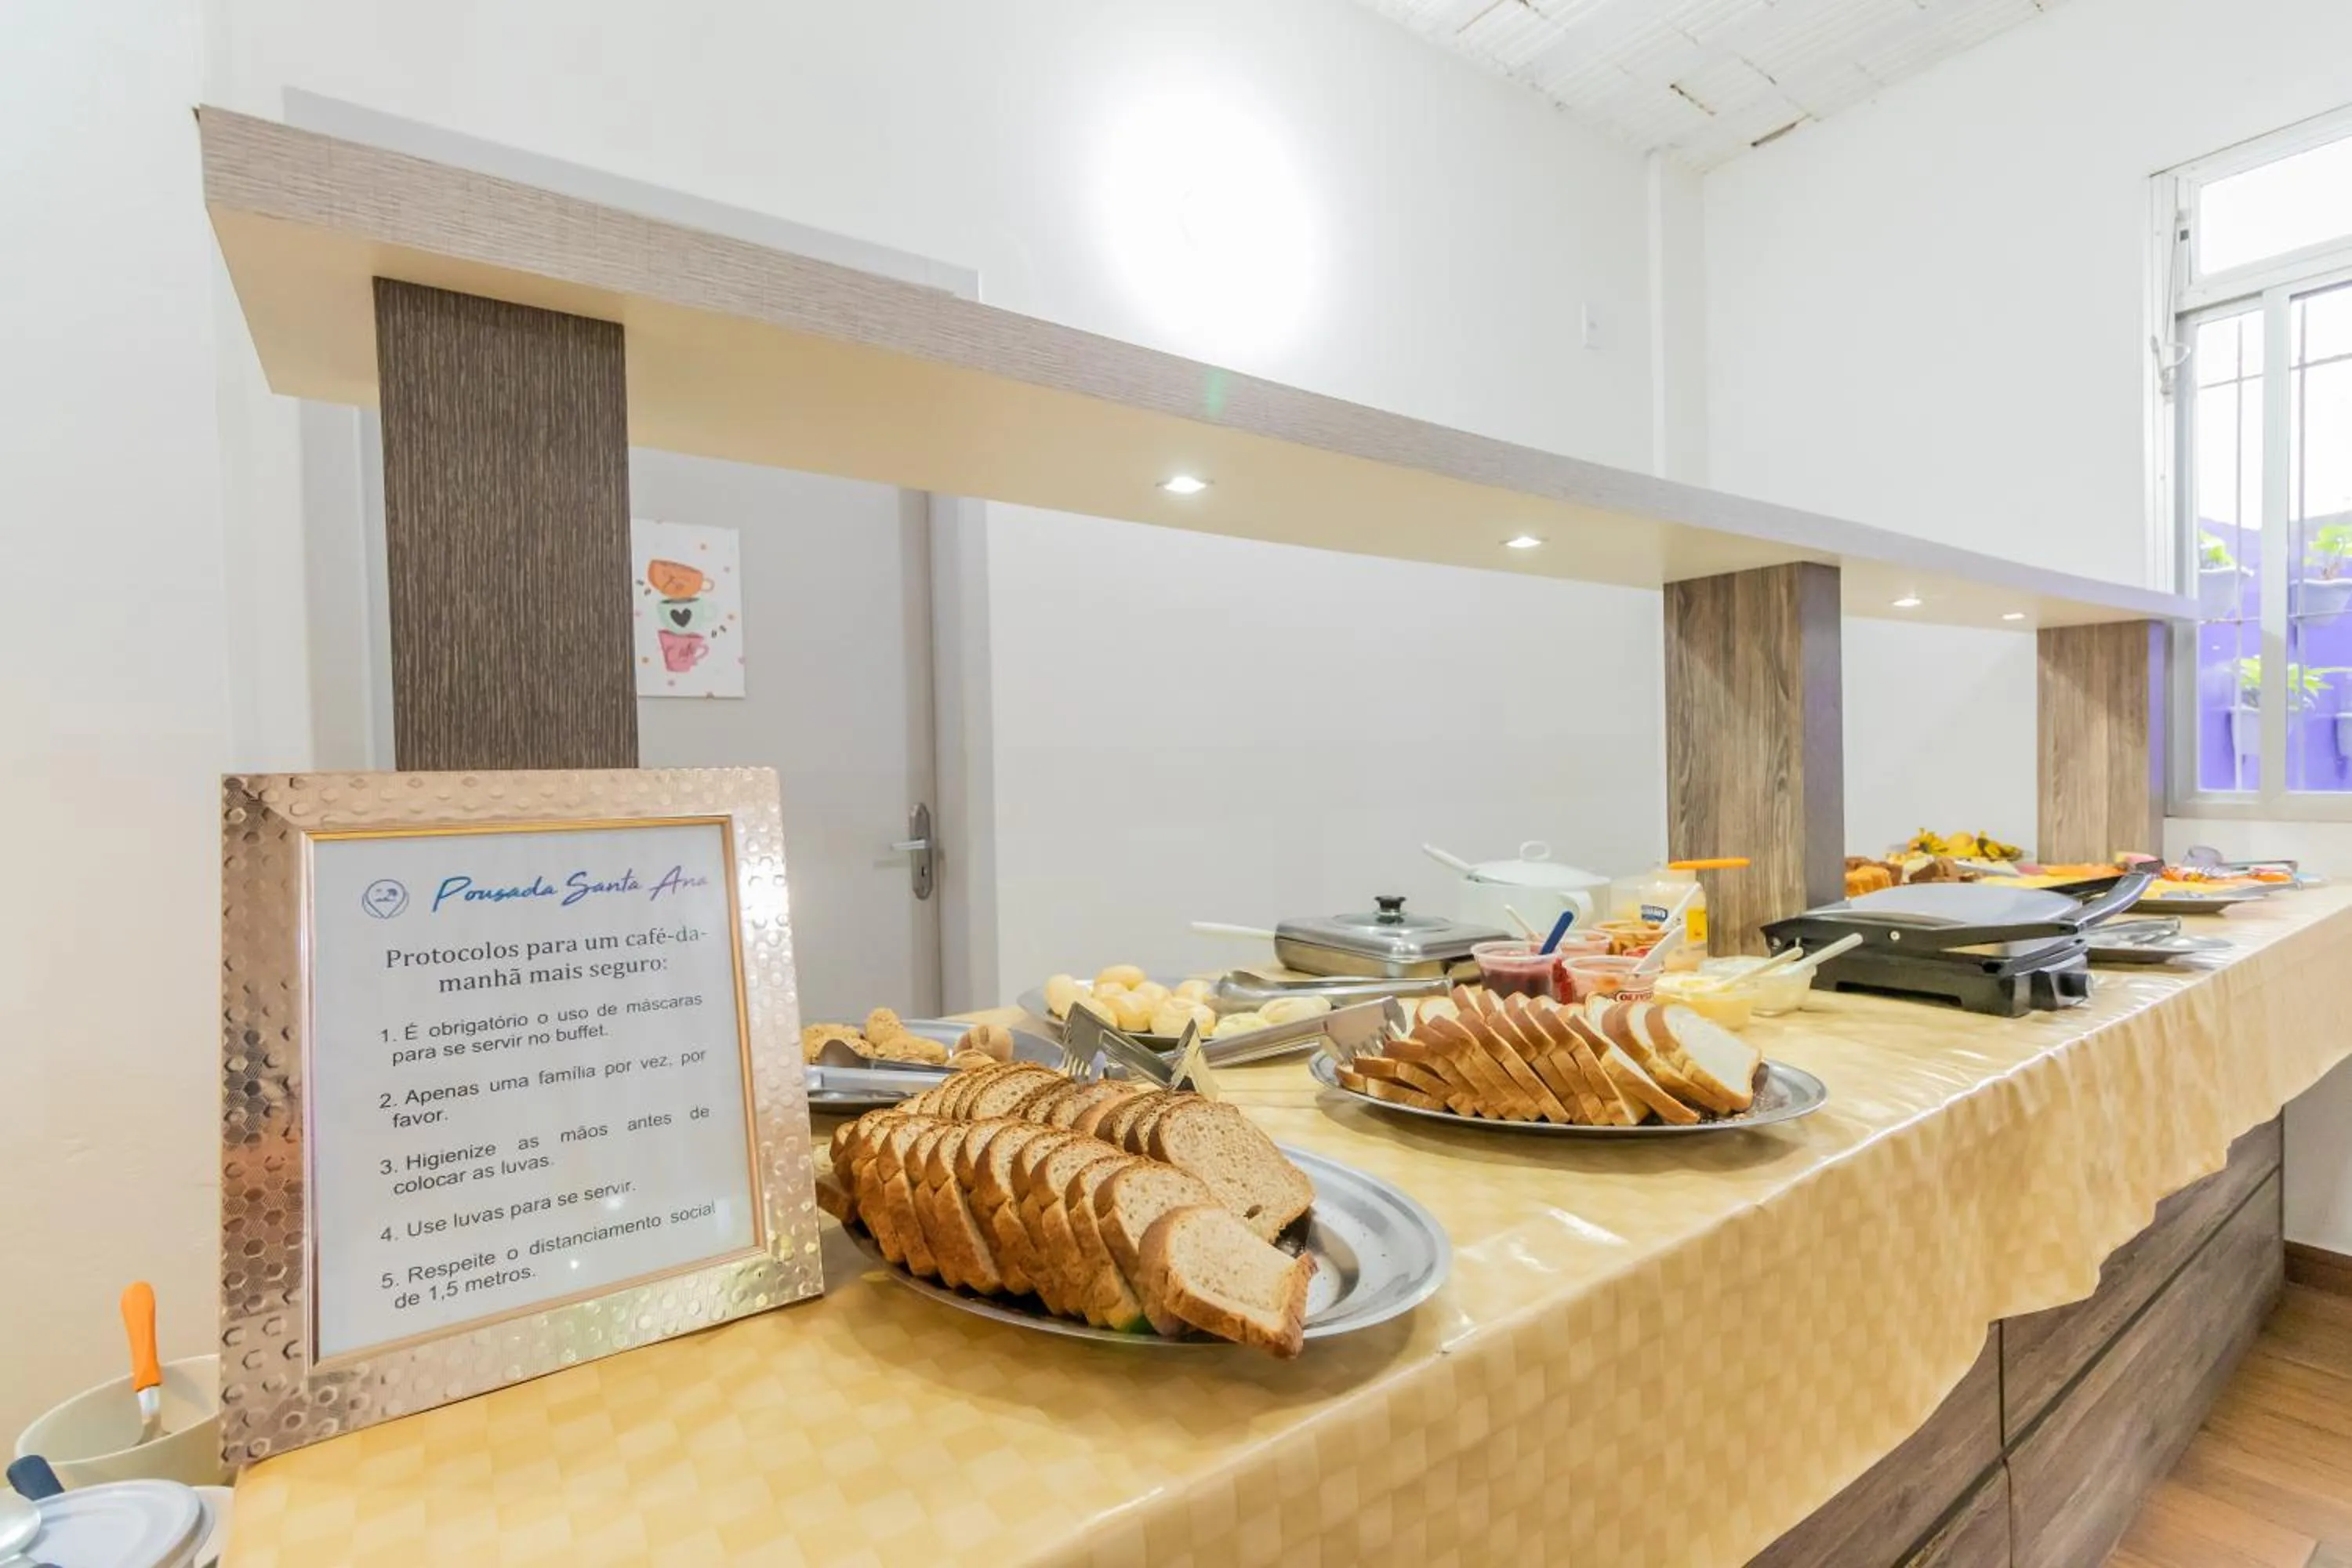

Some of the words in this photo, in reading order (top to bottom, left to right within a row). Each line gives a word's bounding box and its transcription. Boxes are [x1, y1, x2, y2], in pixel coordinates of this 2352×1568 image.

[431, 876, 557, 913] Pousada
[561, 870, 640, 906] Santa
[650, 866, 709, 902] Ana
[386, 942, 519, 968] Protocolos
[526, 938, 578, 960] para
[585, 935, 619, 950] um
[625, 926, 706, 948] café-da-
[438, 967, 522, 993] manhã
[530, 962, 583, 983] mais
[590, 956, 667, 979] seguro:
[381, 1029, 396, 1043] 1.
[404, 1022, 418, 1041] É
[429, 1014, 528, 1040] obrigatório
[537, 1013, 548, 1025] o
[557, 1007, 589, 1022] uso
[597, 1003, 618, 1017] de
[626, 994, 702, 1014] máscaras
[392, 1047, 437, 1066] para
[442, 1043, 464, 1056] se
[471, 1034, 523, 1053] servir
[528, 1032, 550, 1047] no
[556, 1025, 608, 1041] buffet.
[379, 1092, 397, 1109] 2.
[405, 1082, 480, 1107] Apenas
[489, 1074, 529, 1093] uma
[539, 1065, 596, 1086] família
[604, 1060, 631, 1080] por
[681, 1050, 706, 1069] por
[379, 1158, 397, 1174] 3.
[406, 1142, 496, 1171] Higienize
[518, 1135, 539, 1150] as
[561, 1124, 608, 1144] mãos
[627, 1113, 672, 1131] antes
[689, 1105, 710, 1120] de
[393, 1109, 448, 1128] favor.
[393, 1170, 464, 1196] colocar
[472, 1166, 495, 1181] as
[501, 1154, 554, 1175] luvas.
[380, 1226, 397, 1242] 4.
[407, 1218, 448, 1238] Use
[453, 1205, 504, 1228] luvas
[510, 1196, 552, 1219] para
[557, 1192, 579, 1207] se
[583, 1180, 636, 1200] servir.
[381, 1272, 398, 1289] 5.
[408, 1253, 495, 1283] Respeite
[507, 1248, 519, 1260] o
[529, 1215, 662, 1256] distanciamento
[670, 1200, 716, 1224] social
[394, 1291, 420, 1309] de
[429, 1280, 459, 1302] 1,5
[465, 1265, 535, 1293] metros.
